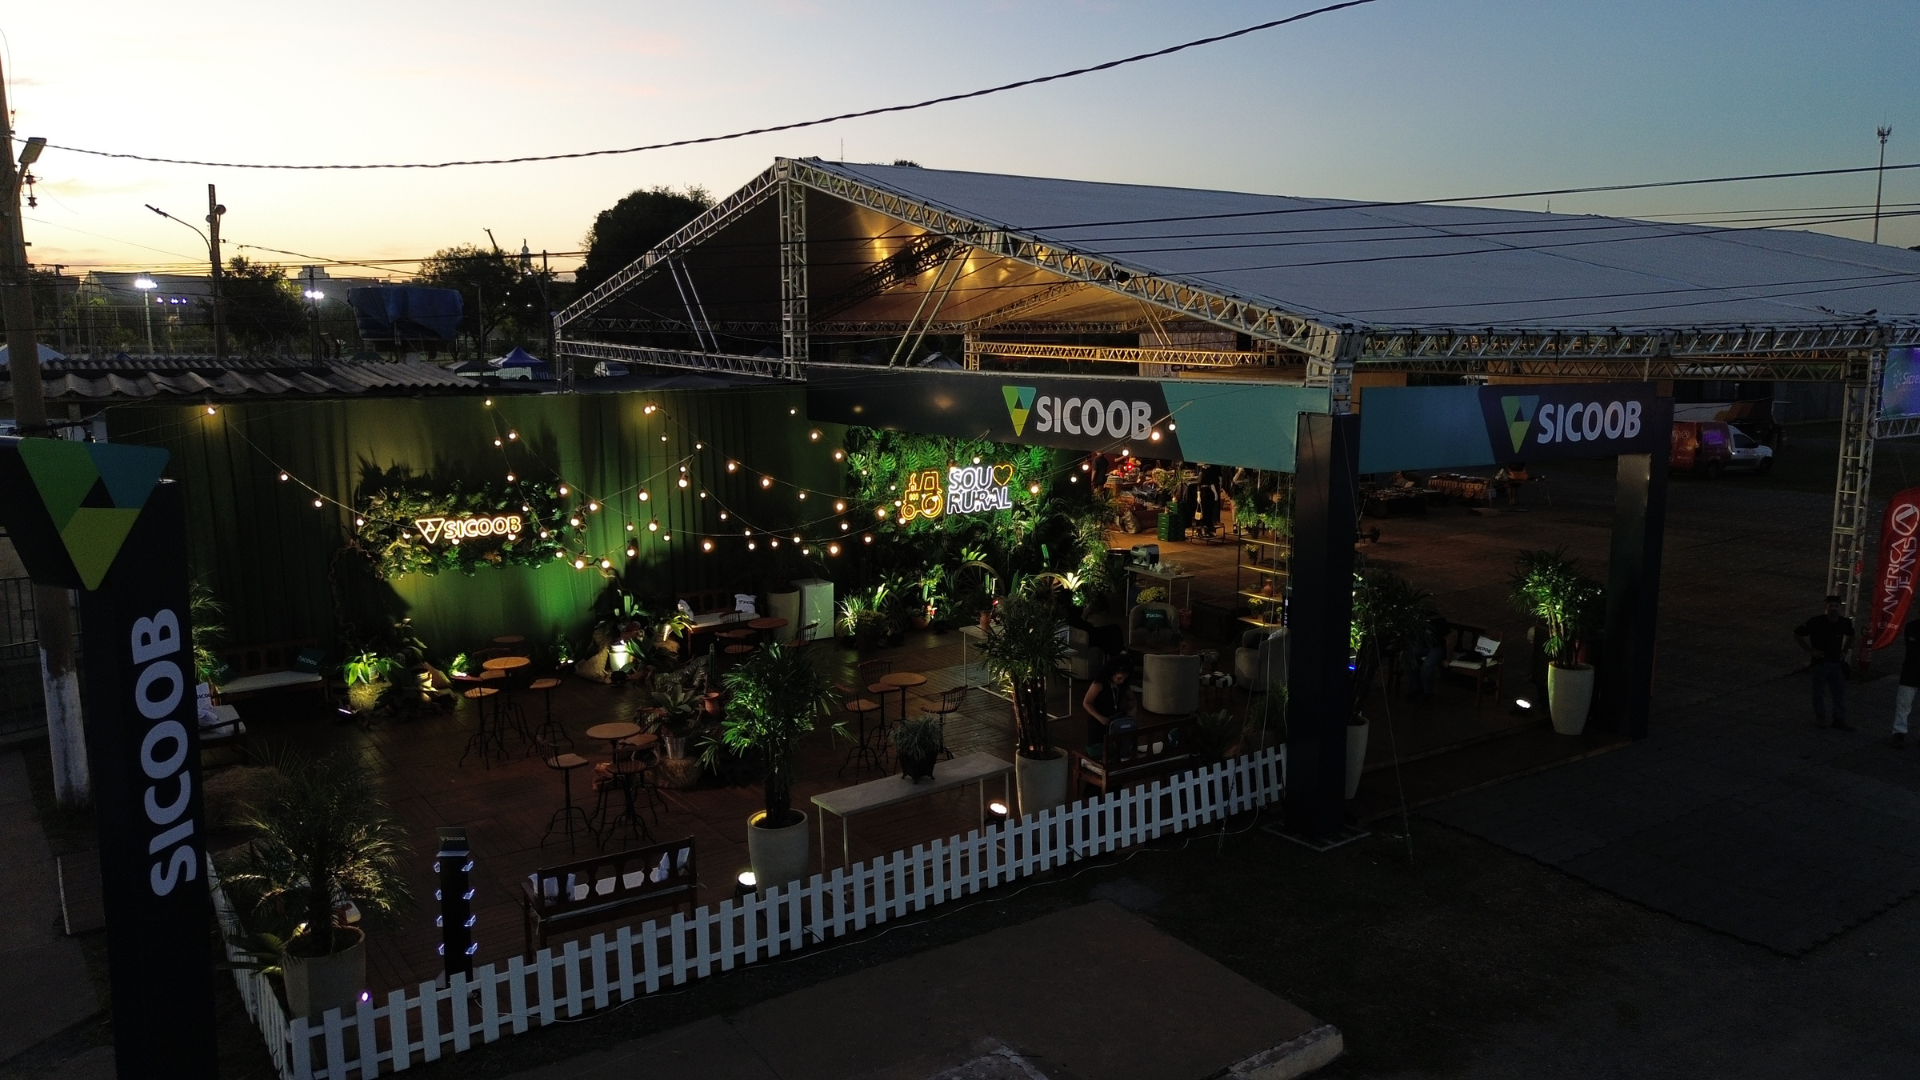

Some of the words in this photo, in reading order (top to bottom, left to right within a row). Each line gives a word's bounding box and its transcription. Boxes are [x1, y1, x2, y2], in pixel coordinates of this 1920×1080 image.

[1902, 372, 1920, 385] Sicre
[1036, 396, 1152, 440] SICOOB
[1537, 399, 1642, 446] SICOOB
[948, 465, 993, 492] SOU
[946, 487, 1012, 515] RURAL
[444, 516, 521, 539] SICOOB
[1899, 536, 1918, 595] JEANS
[131, 608, 197, 897] SICOOB
